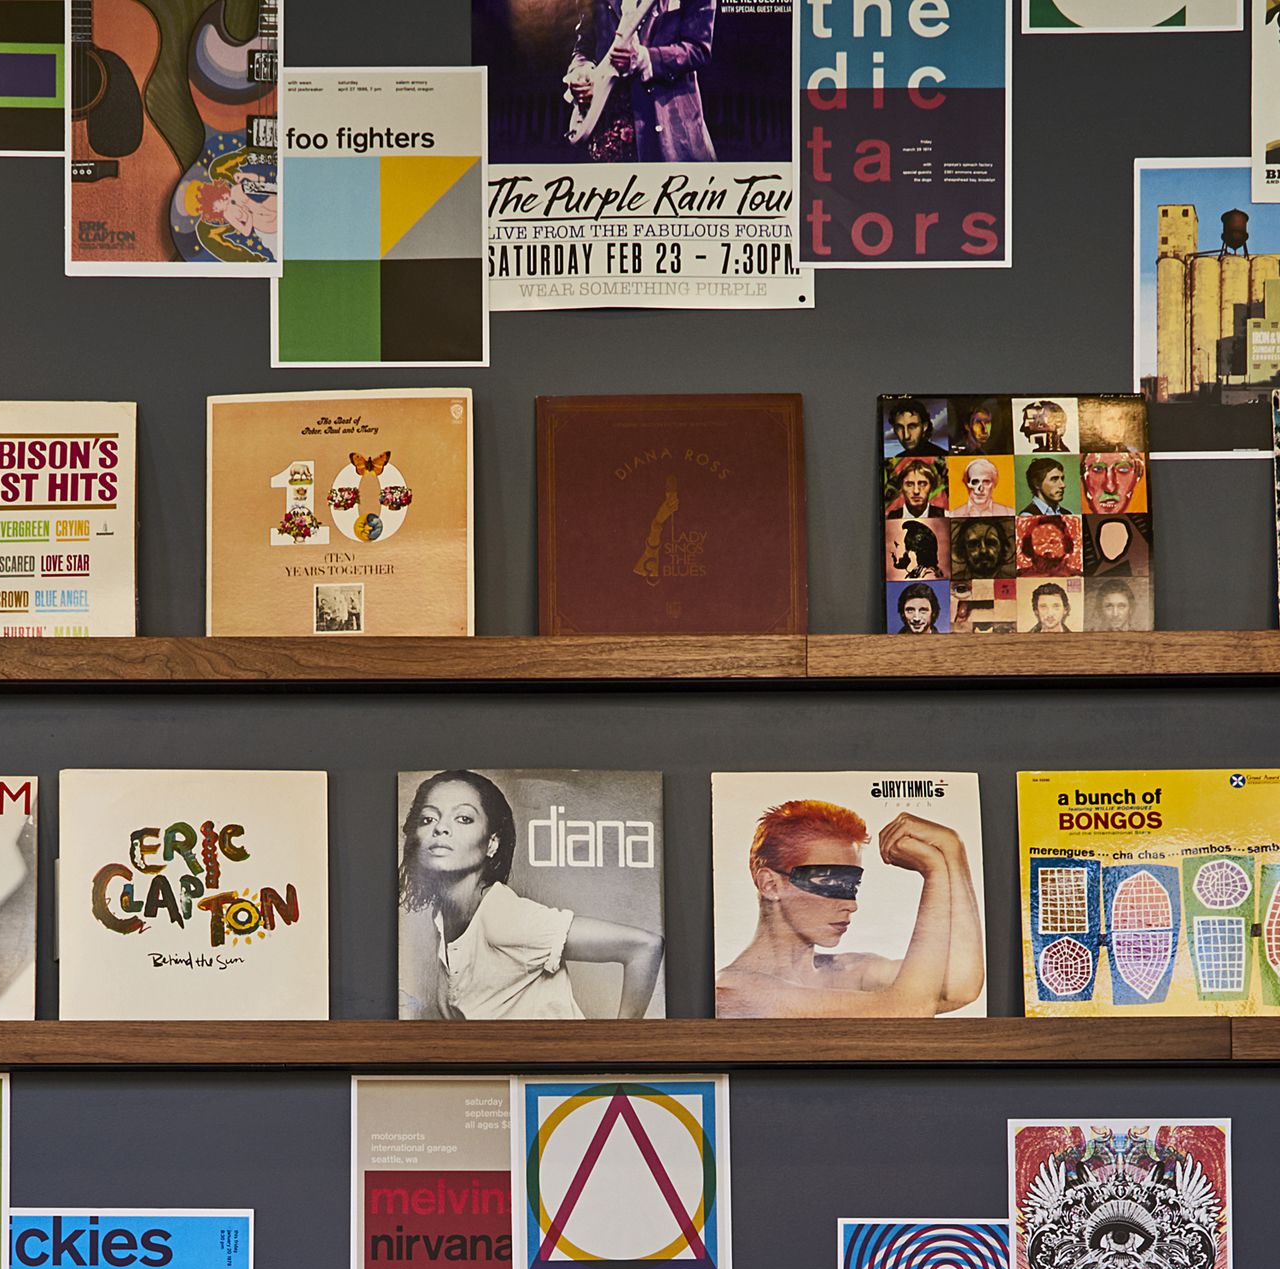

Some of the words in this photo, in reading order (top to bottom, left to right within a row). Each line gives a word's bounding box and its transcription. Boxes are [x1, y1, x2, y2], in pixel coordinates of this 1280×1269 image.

[807, 0, 951, 39] the
[286, 127, 328, 150] foo
[335, 126, 436, 154] fighters
[544, 174, 651, 221] Purple
[652, 174, 728, 217] Rain
[532, 224, 586, 239] FROM
[590, 224, 628, 238] THE
[633, 223, 730, 238] FABULOUS
[807, 199, 999, 256] tors
[488, 244, 593, 277] SATURDAY
[607, 242, 642, 274] FEB
[656, 242, 681, 275] 23
[519, 282, 575, 297] WEAR
[579, 281, 691, 297] SOMETHING
[695, 281, 768, 297] PURPLE
[615, 448, 673, 481] DIANA
[684, 449, 731, 480] ROSS
[47, 472, 118, 502] HITS
[55, 519, 90, 537] CRYING
[664, 543, 705, 554] SINGS
[41, 554, 64, 572] LOVE
[66, 554, 90, 572] STAR
[324, 552, 355, 564] (TEN)
[670, 554, 696, 565] THE
[284, 566, 325, 577] YEARS
[327, 565, 395, 576] TOGETHER
[663, 565, 707, 577] BLUES
[35, 590, 58, 608] BLUE
[60, 589, 90, 607] ANGEL
[1057, 792, 1069, 806] a
[1075, 788, 1140, 806] bunch
[1141, 788, 1163, 805] of
[1058, 811, 1163, 831] BONGOS
[528, 806, 655, 869] diana
[129, 820, 251, 889] ERIC
[1029, 846, 1095, 859] merengues
[1112, 850, 1135, 861] cha
[1137, 850, 1166, 860] chas
[1180, 843, 1233, 856] mambos
[91, 863, 300, 947] CLAPTON
[147, 952, 194, 970] Behind
[215, 954, 245, 970] Sun
[465, 1097, 503, 1107] saturday
[465, 1120, 476, 1130] all
[477, 1121, 500, 1131] ages
[371, 1132, 426, 1143] motorsports
[371, 1143, 426, 1153] international
[427, 1144, 458, 1155] garage
[371, 1154, 404, 1165] seattle,
[405, 1156, 419, 1165] wa
[370, 1225, 513, 1261] nirvana
